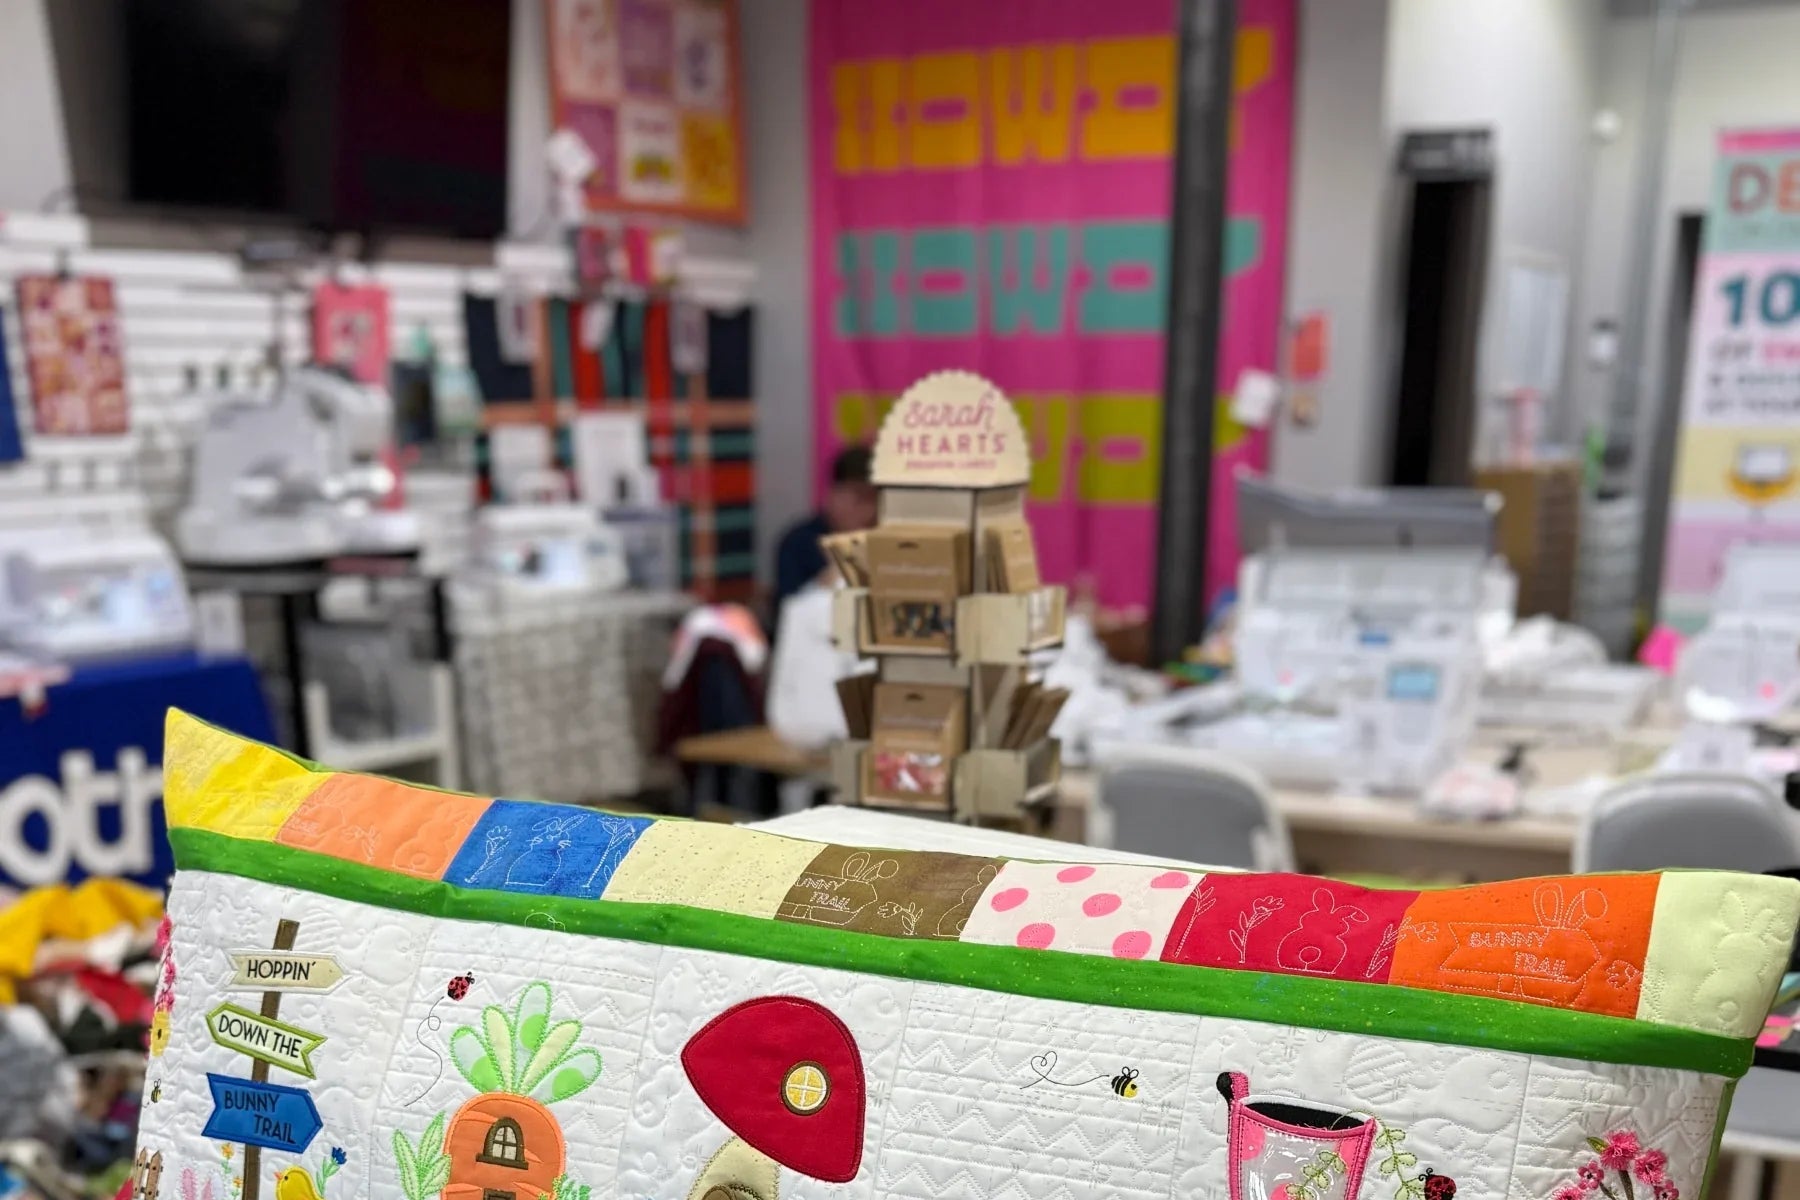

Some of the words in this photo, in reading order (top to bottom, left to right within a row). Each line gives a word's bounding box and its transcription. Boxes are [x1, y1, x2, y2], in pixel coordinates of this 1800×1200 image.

[897, 432, 1006, 454] HEARTS
[1469, 930, 1549, 948] BUNNY
[1514, 951, 1568, 979] TRAIL
[218, 1014, 270, 1047] DOWN
[273, 1031, 303, 1059] THE
[223, 1090, 281, 1113] BUNNY
[253, 1114, 297, 1145] TRAIL
